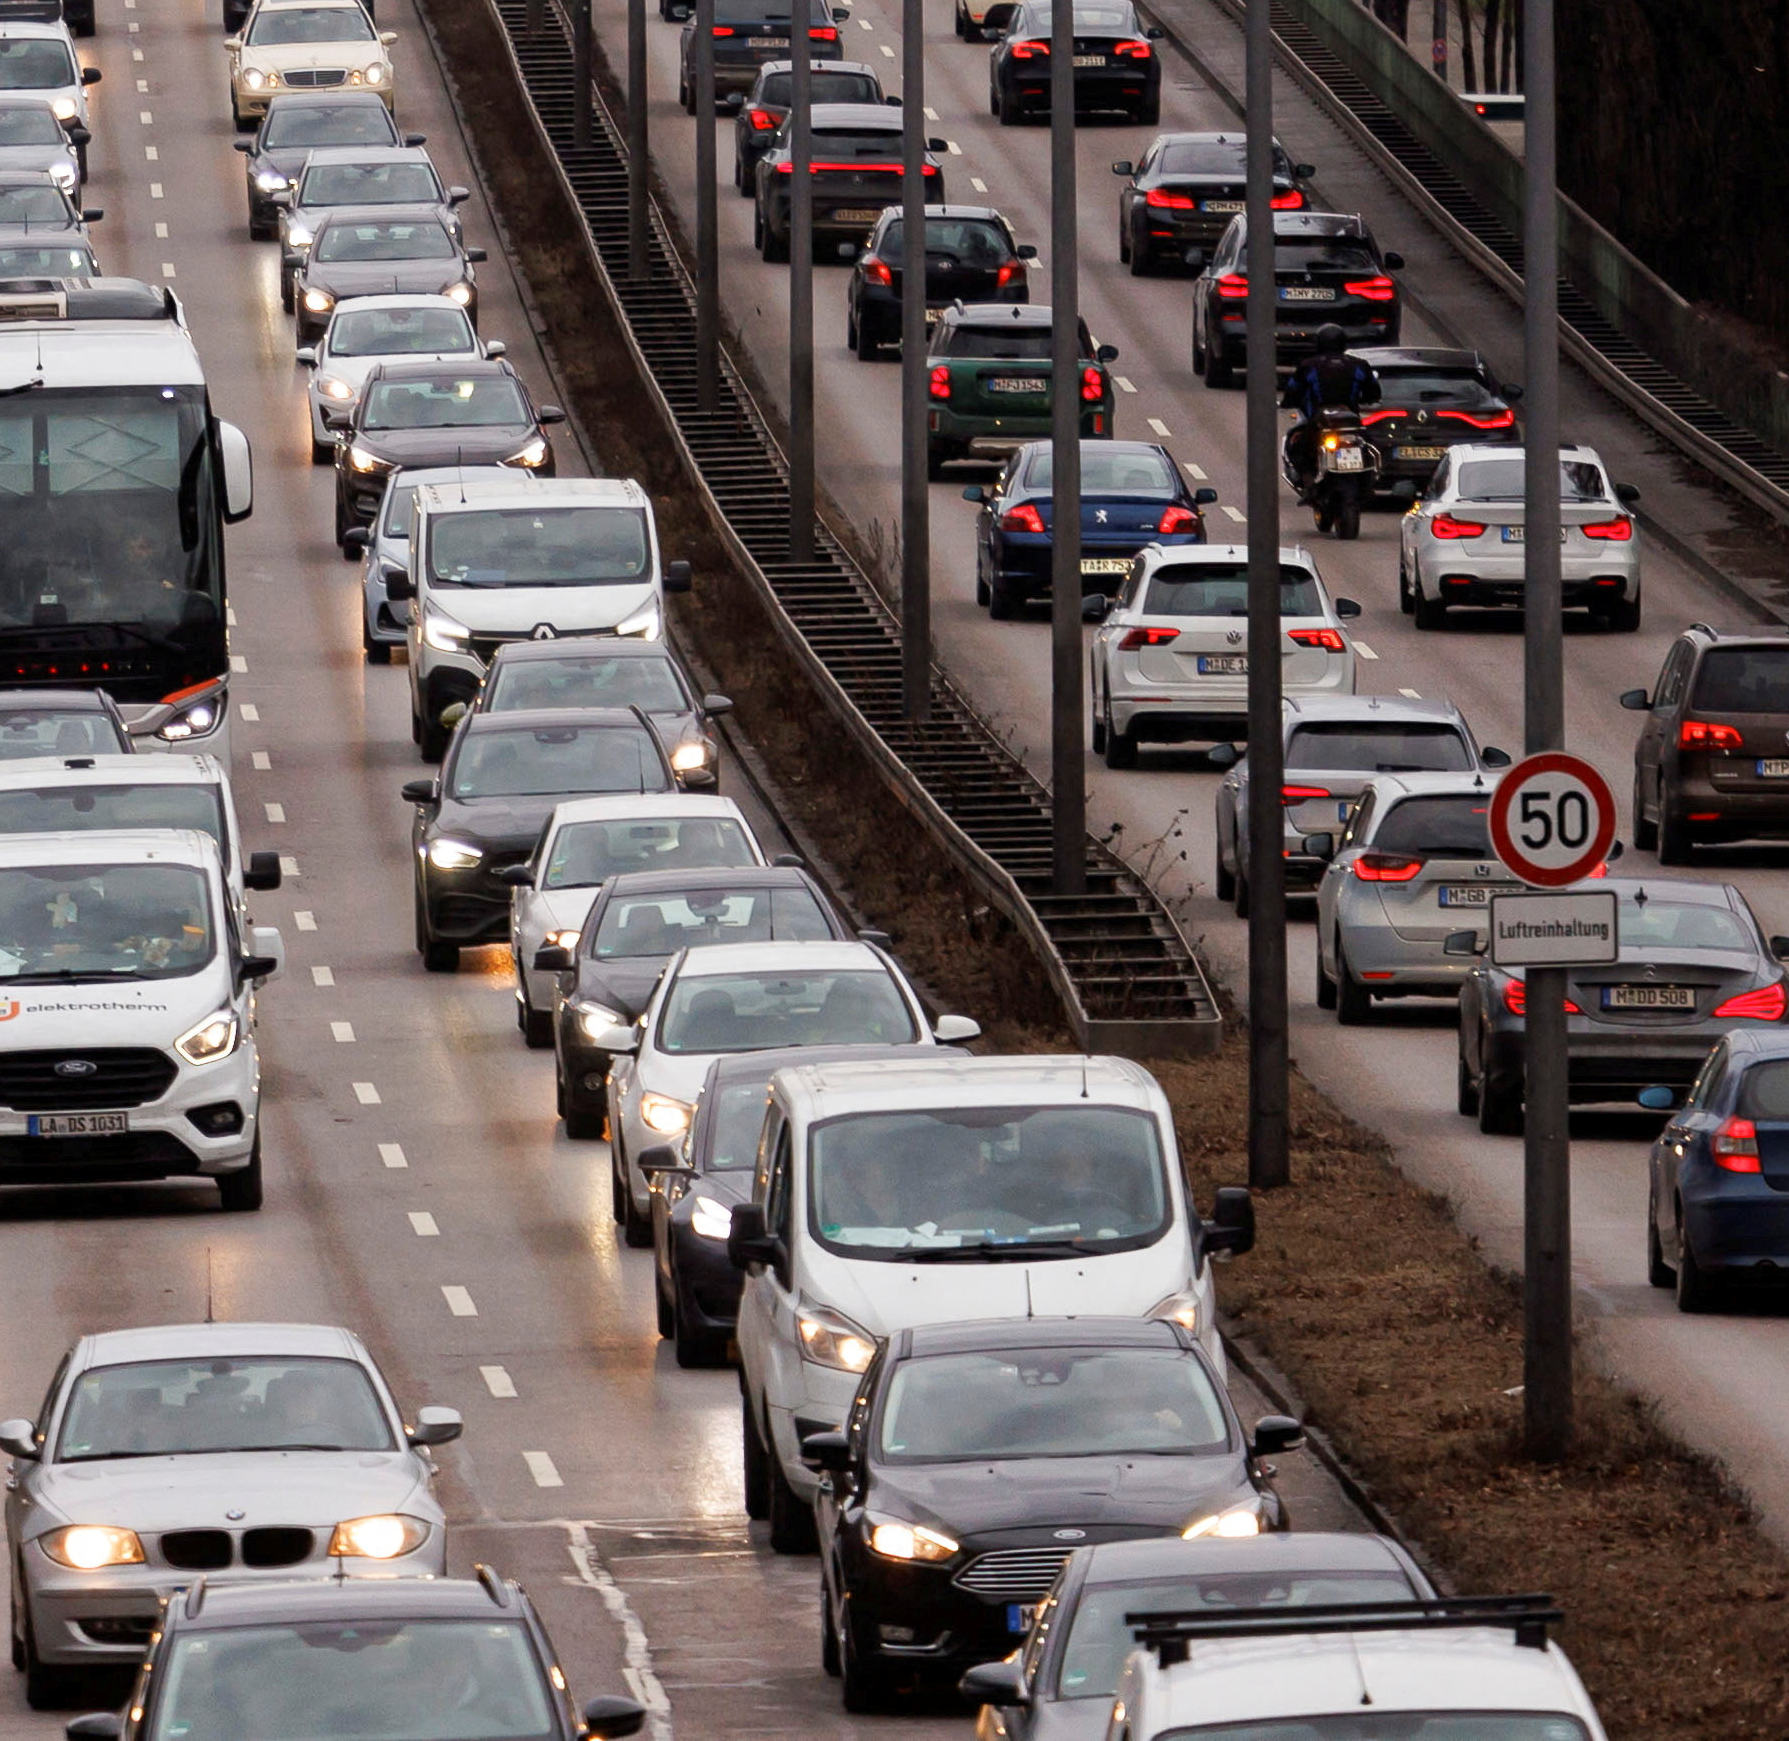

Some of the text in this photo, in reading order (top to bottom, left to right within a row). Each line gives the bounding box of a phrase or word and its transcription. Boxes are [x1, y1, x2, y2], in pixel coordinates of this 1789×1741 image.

[1521, 791, 1588, 849] 50
[1448, 889, 1485, 903] M GB
[1499, 918, 1609, 941] Luftreinhaltung
[1616, 990, 1626, 1004] M
[1659, 990, 1687, 1005] 508
[26, 1002, 168, 1013] elektrotherm
[39, 1115, 125, 1133] LA DS 1031
[1021, 1608, 1035, 1628] M
